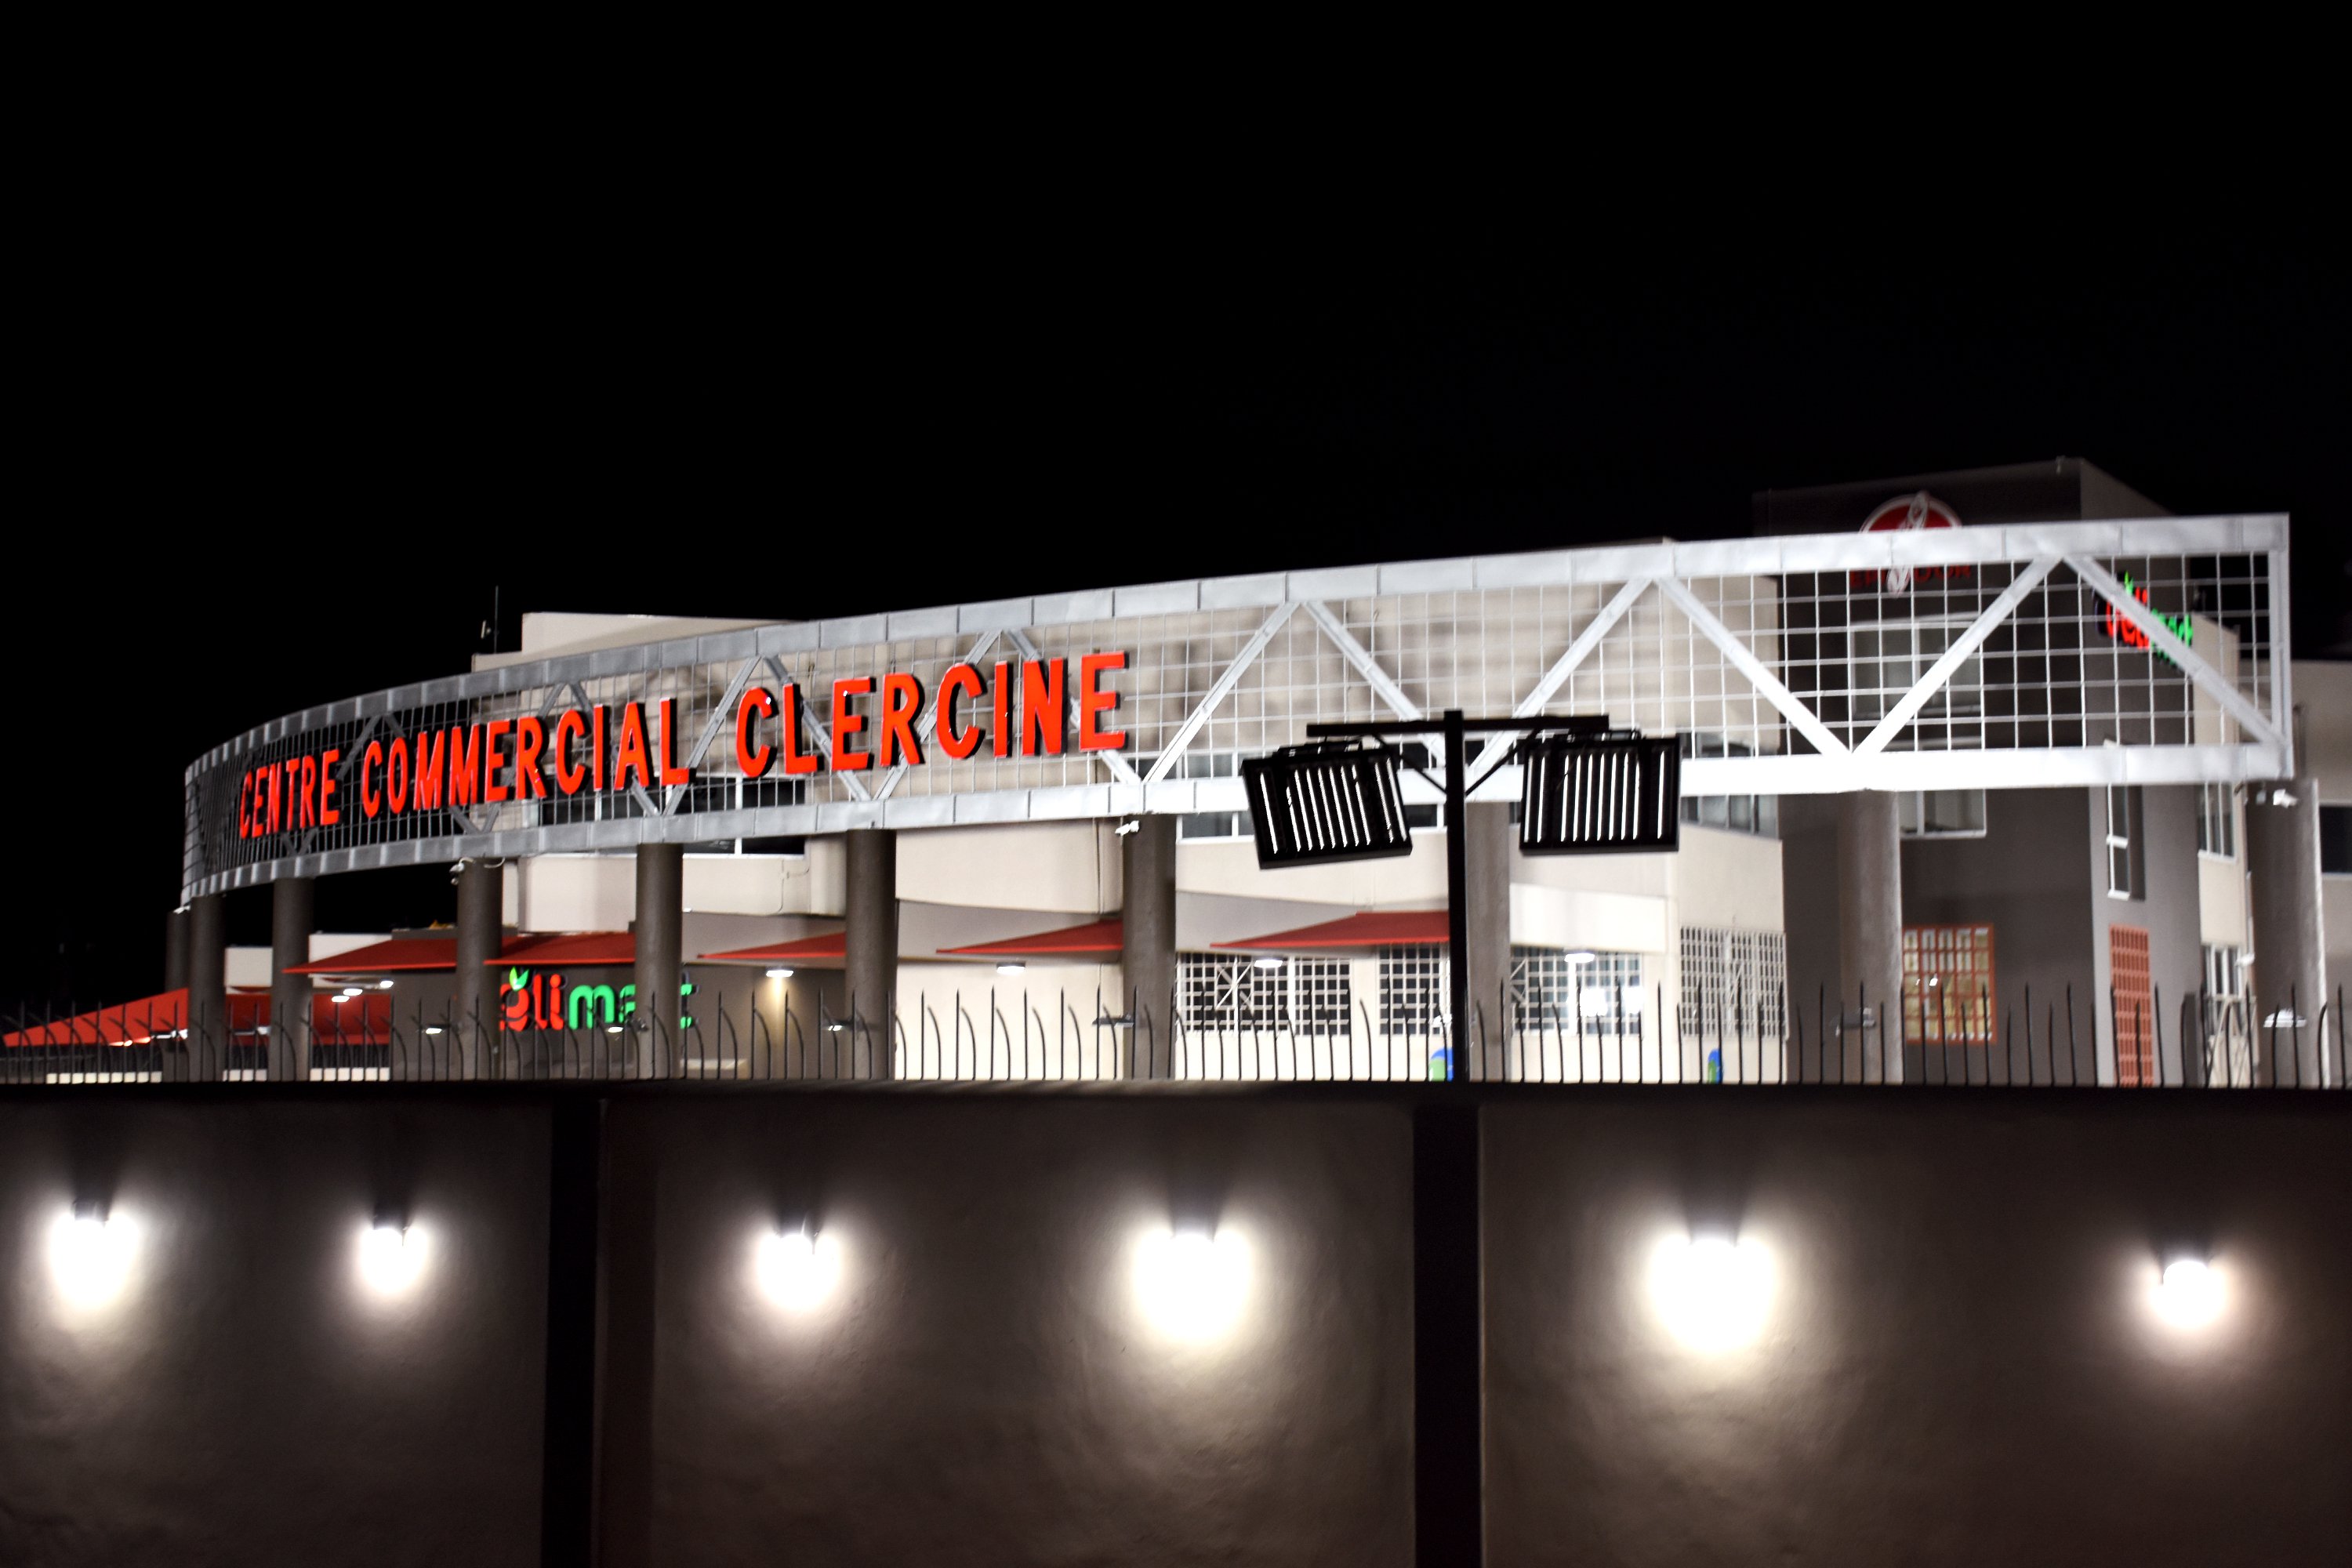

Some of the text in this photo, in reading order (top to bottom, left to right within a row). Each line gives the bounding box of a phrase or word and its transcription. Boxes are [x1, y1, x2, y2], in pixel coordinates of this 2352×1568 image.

[238, 650, 1129, 840] CENTRE COMMERCIAL CLERCINE
